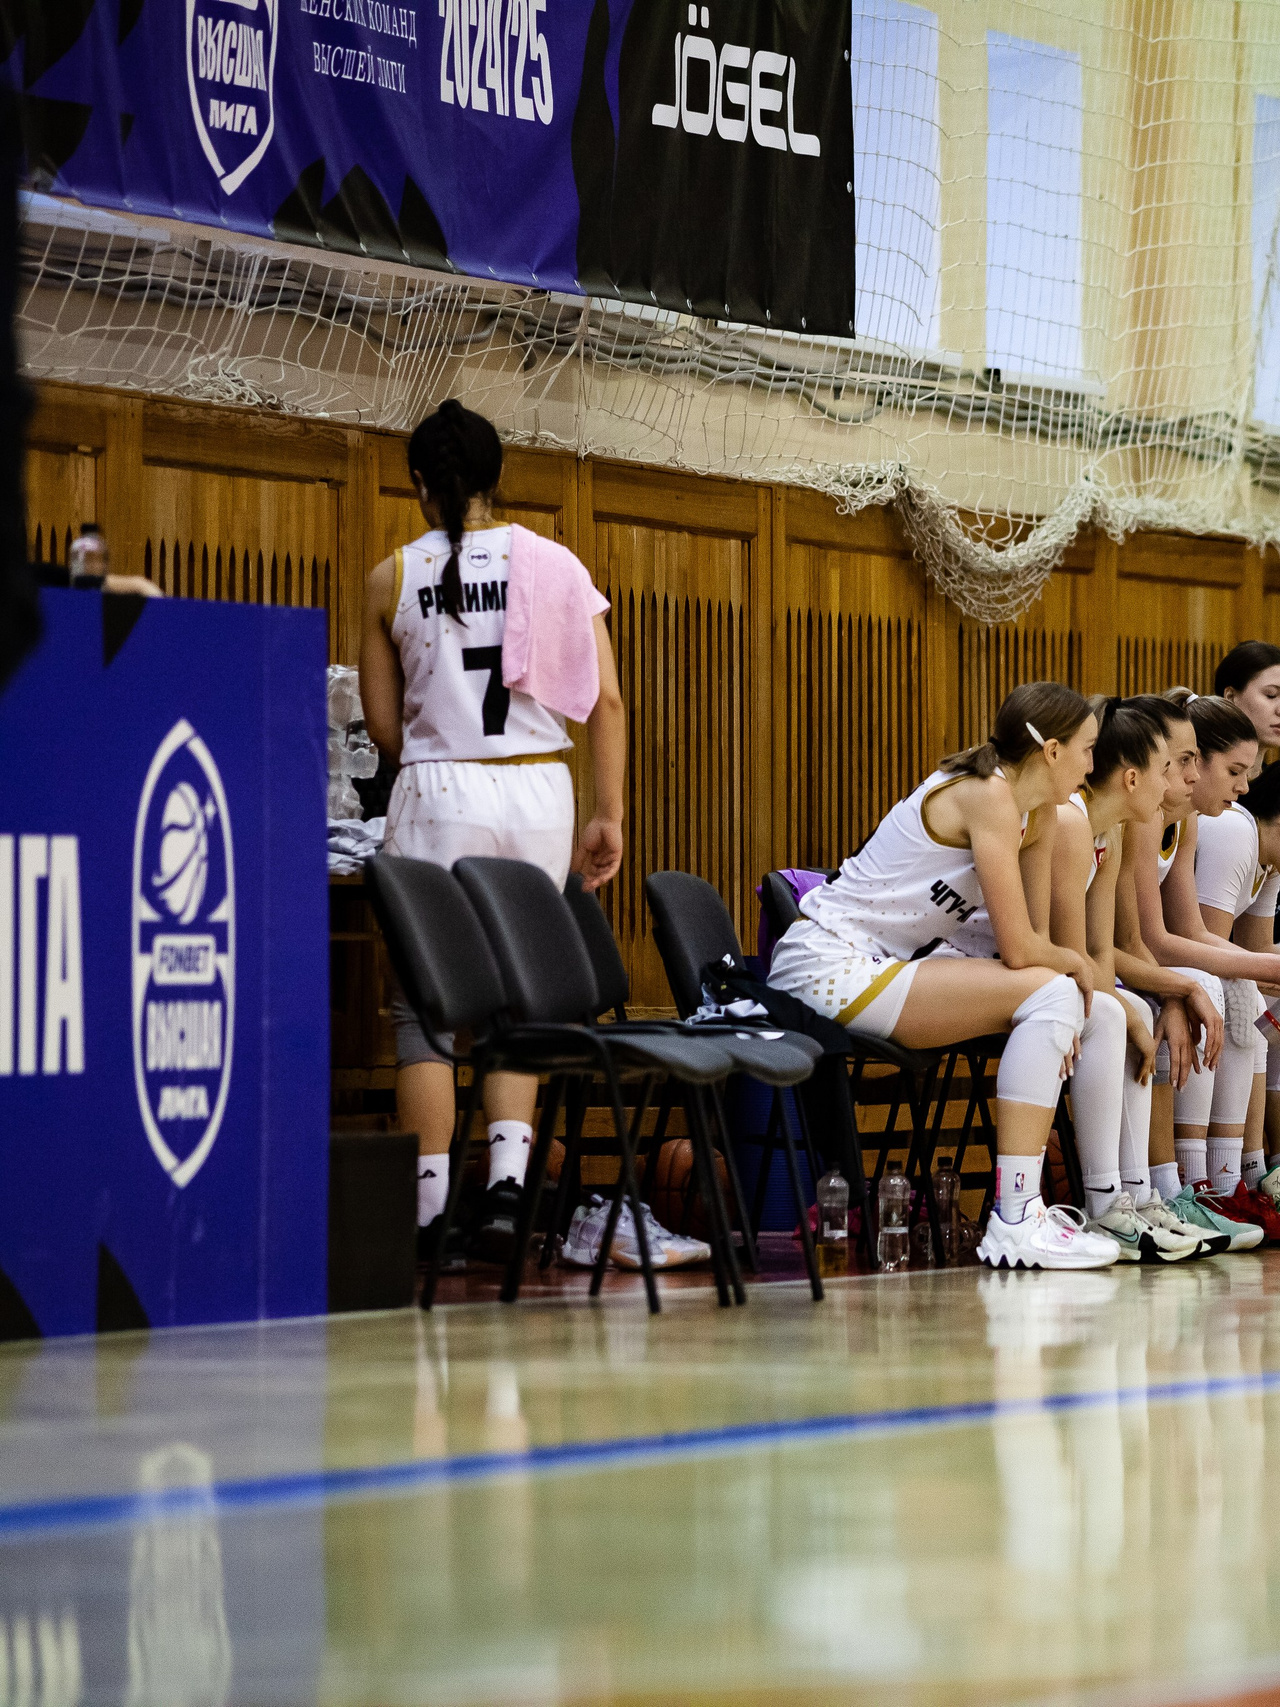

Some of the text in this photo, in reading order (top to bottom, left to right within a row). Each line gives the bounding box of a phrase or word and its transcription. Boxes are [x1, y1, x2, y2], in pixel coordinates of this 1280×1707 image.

[197, 15, 267, 92] ВЫСШАЯ
[367, 0, 417, 49] КОМАНД
[313, 41, 406, 94] ВЫСШЕЙ ЛИГИ
[438, 0, 554, 125] 2024/25
[652, 3, 821, 157] JÖGEL
[209, 98, 258, 136] ЛИГА
[418, 579, 508, 619] РАИМ
[462, 645, 510, 736] 7
